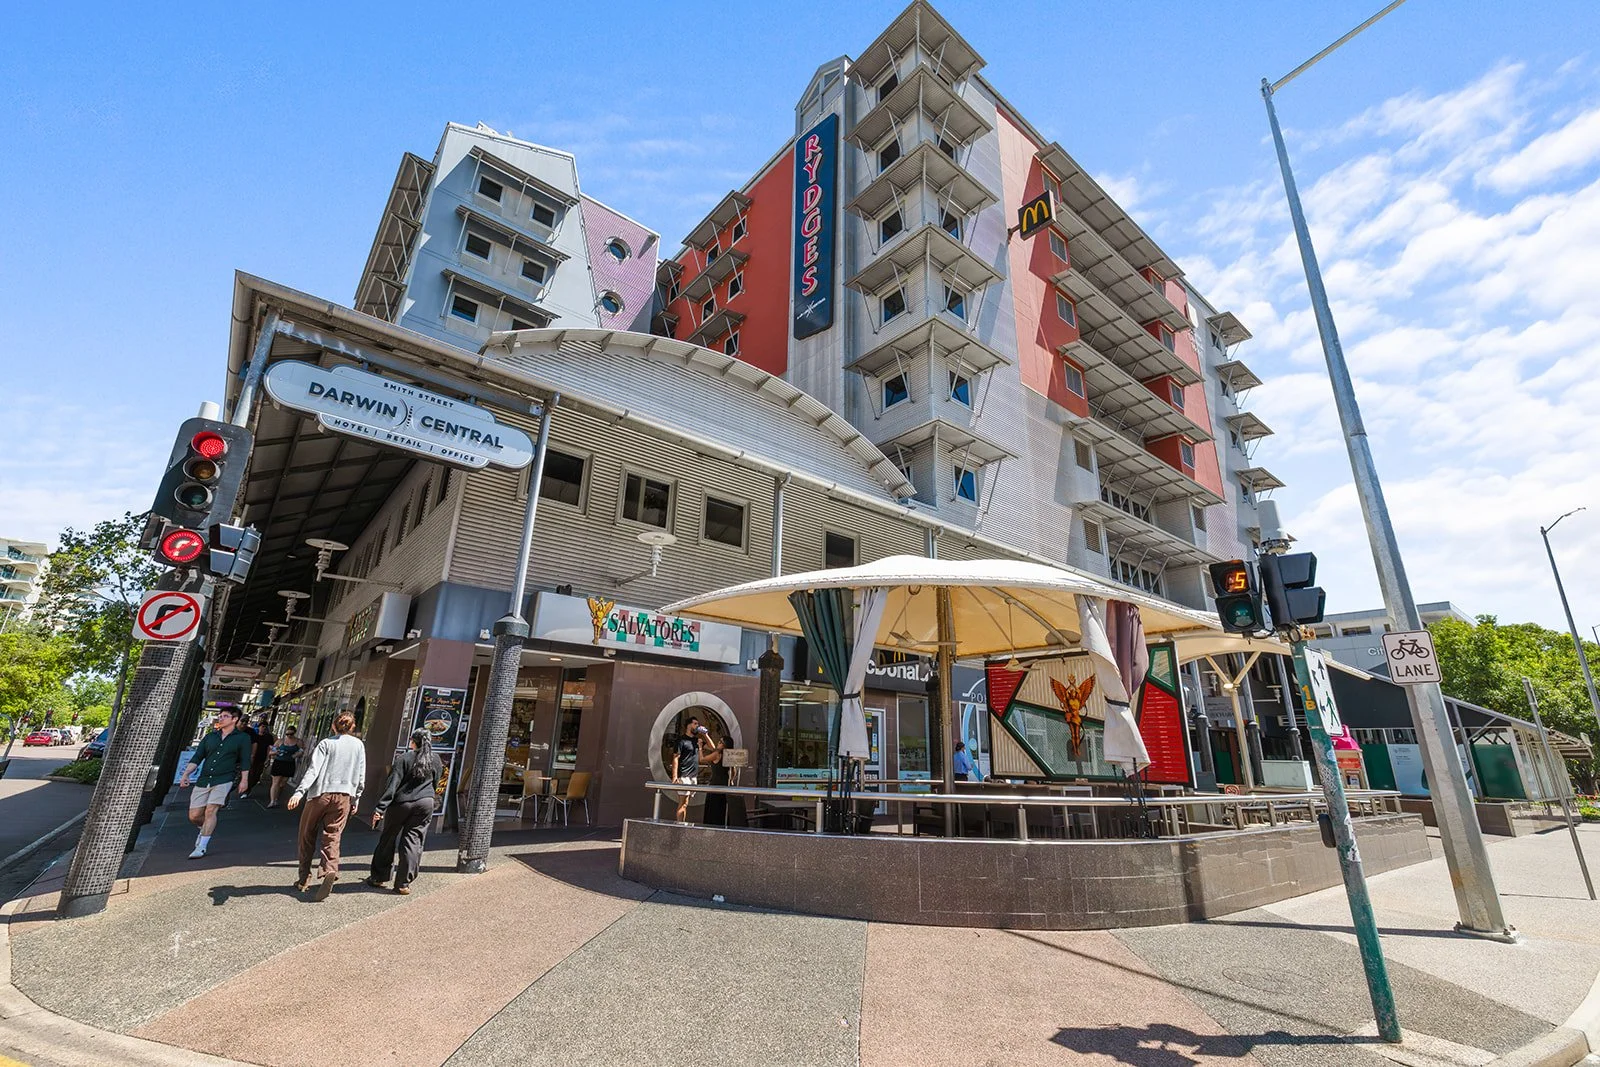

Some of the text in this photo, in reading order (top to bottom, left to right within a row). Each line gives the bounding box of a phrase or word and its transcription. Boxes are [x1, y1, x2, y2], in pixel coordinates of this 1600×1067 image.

[801, 133, 823, 297] RYDGES
[308, 381, 398, 419] DARWIN
[383, 382, 454, 408] SMITH STREET
[334, 419, 476, 462] HOTEL RETAIL OFFICE
[421, 415, 504, 450] CENTRAL
[1367, 647, 1385, 657] Cit
[1395, 664, 1434, 678] LANE
[1301, 684, 1312, 702] 1
[1305, 700, 1317, 711] B
